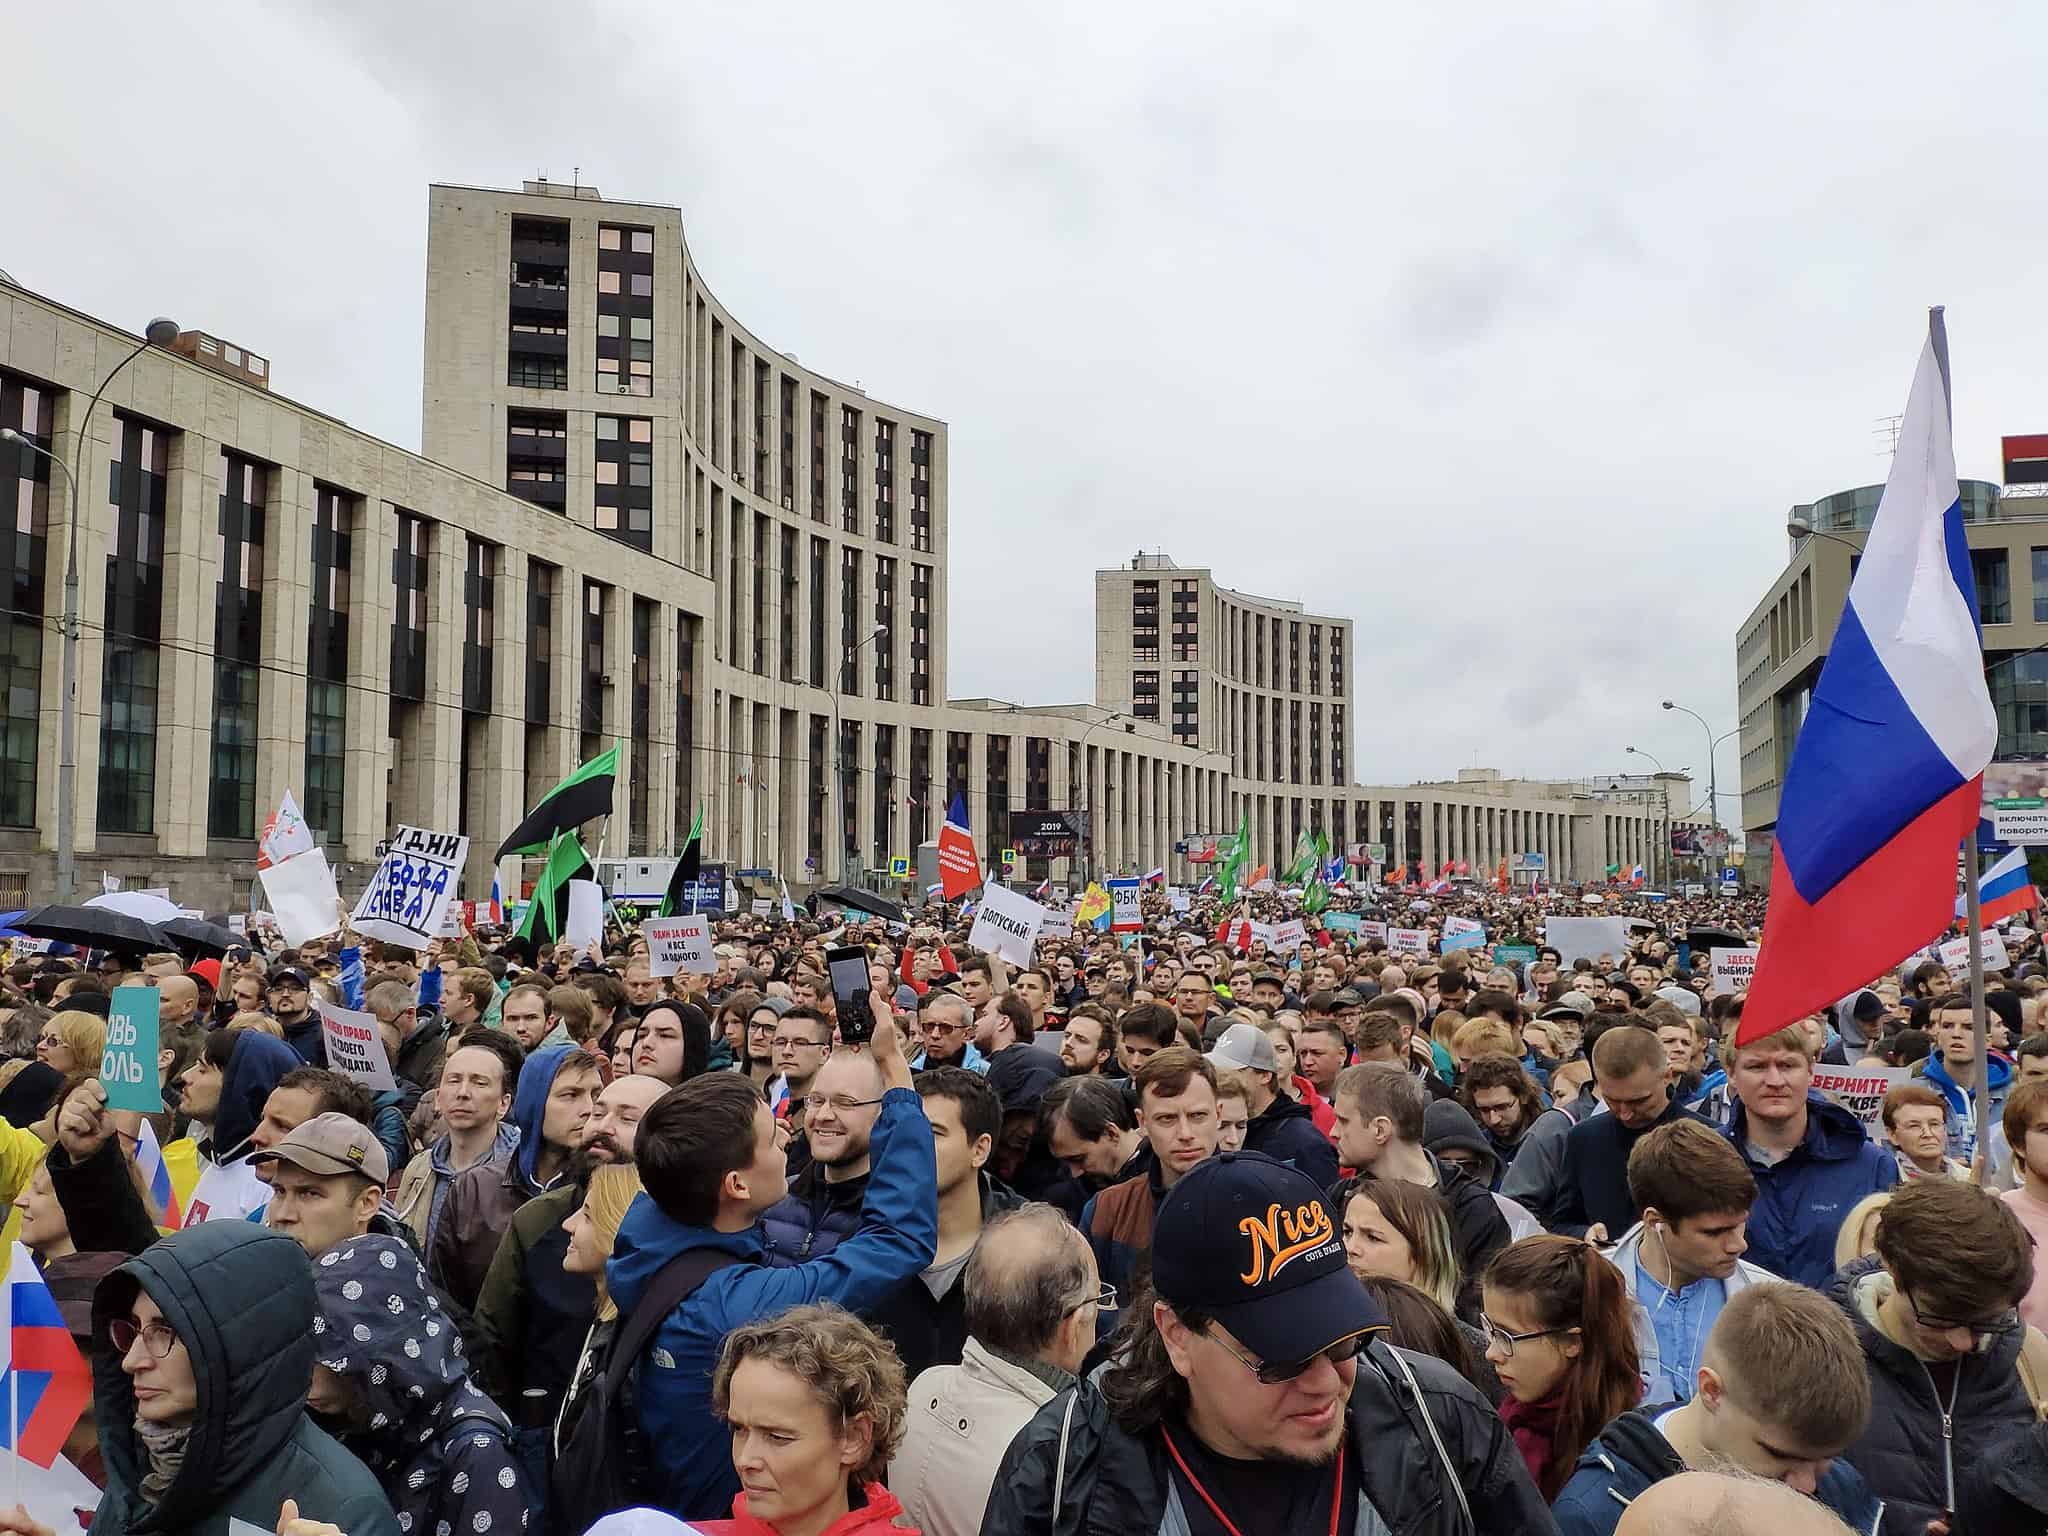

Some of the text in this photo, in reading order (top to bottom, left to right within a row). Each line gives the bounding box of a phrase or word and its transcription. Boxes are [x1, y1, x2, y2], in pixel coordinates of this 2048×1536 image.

[1040, 822, 1062, 831] 2019
[1114, 889, 1138, 905] ФБК
[981, 907, 1032, 941] ДОПУСКАЙ!
[653, 930, 671, 939] ОДИН
[1727, 954, 1755, 966] ЗДЕСЬ
[1717, 965, 1754, 976] ВЫБИРА
[344, 1023, 373, 1042] ПРАВО
[102, 1049, 144, 1083] ОЛЬ
[1812, 1075, 1888, 1094] ВЕРНИТЕ
[1239, 1200, 1334, 1287] Nice
